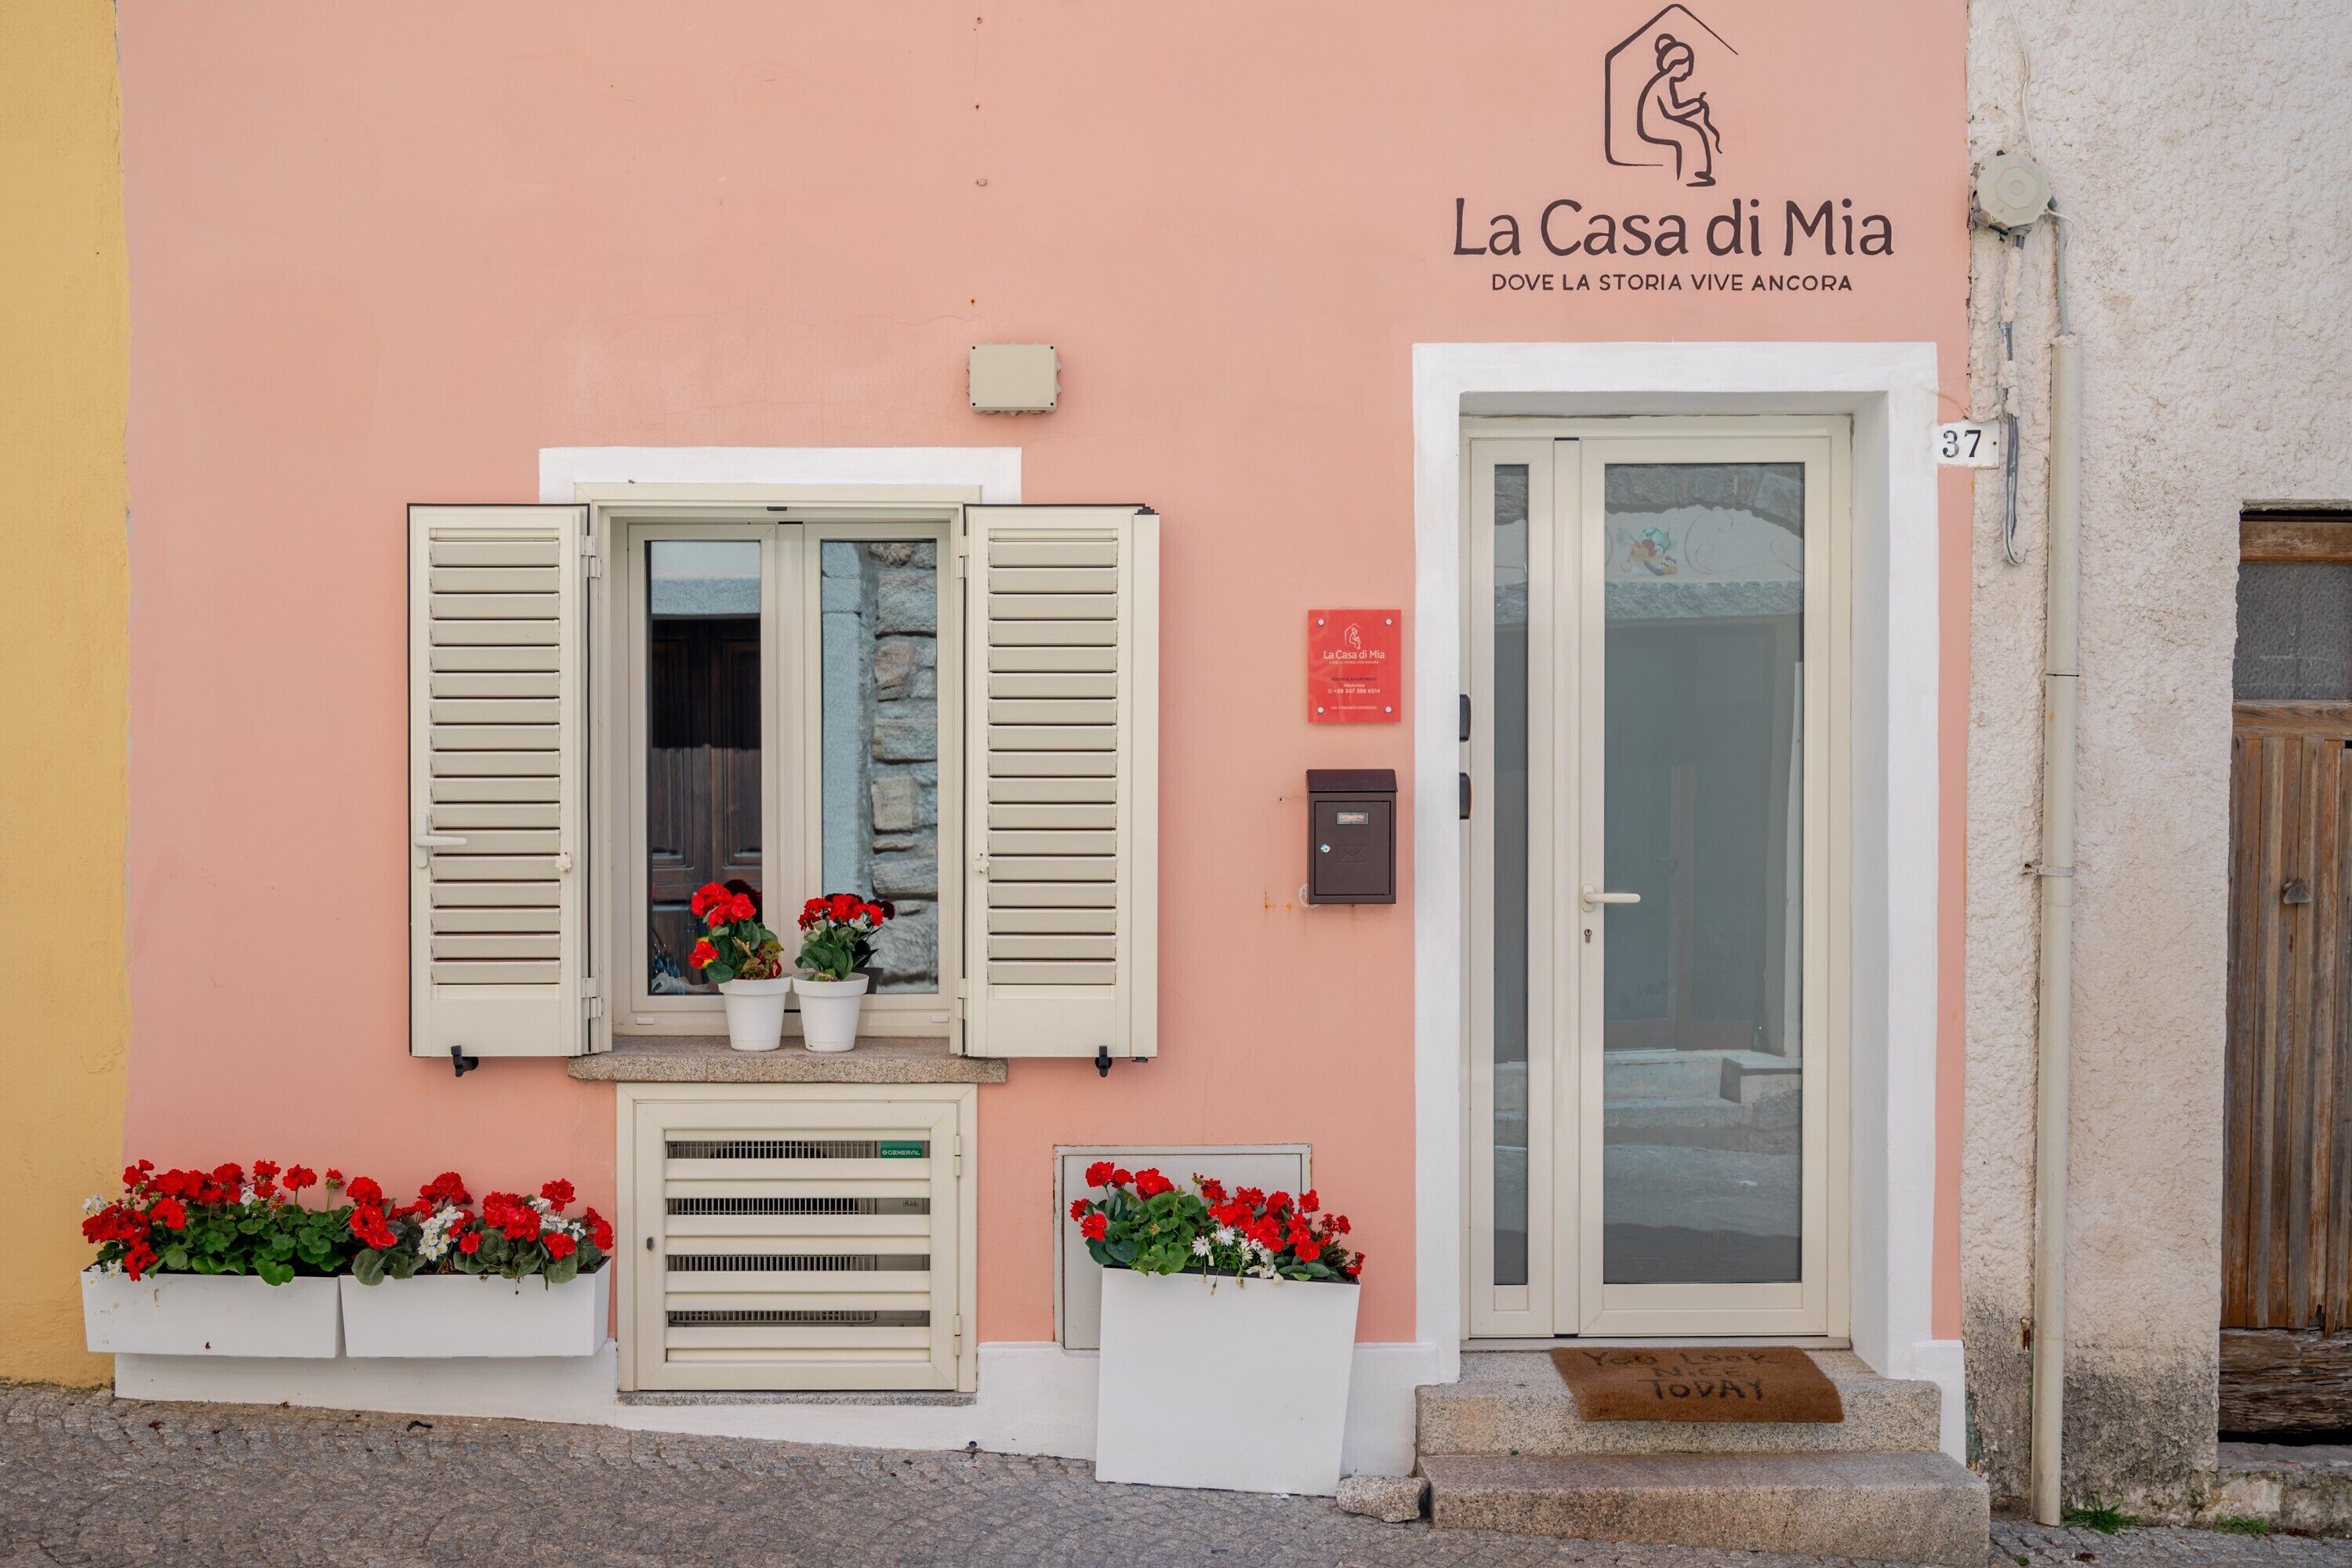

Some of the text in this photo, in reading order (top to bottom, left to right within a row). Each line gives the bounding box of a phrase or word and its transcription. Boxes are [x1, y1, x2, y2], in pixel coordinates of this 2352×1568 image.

[1453, 198, 1895, 257] La Casa di Mia
[1492, 274, 1853, 292] DOVE LA STORIA VIVE ANCORA
[1942, 429, 1982, 458] 37
[1323, 649, 1385, 659] La Casa di Mia
